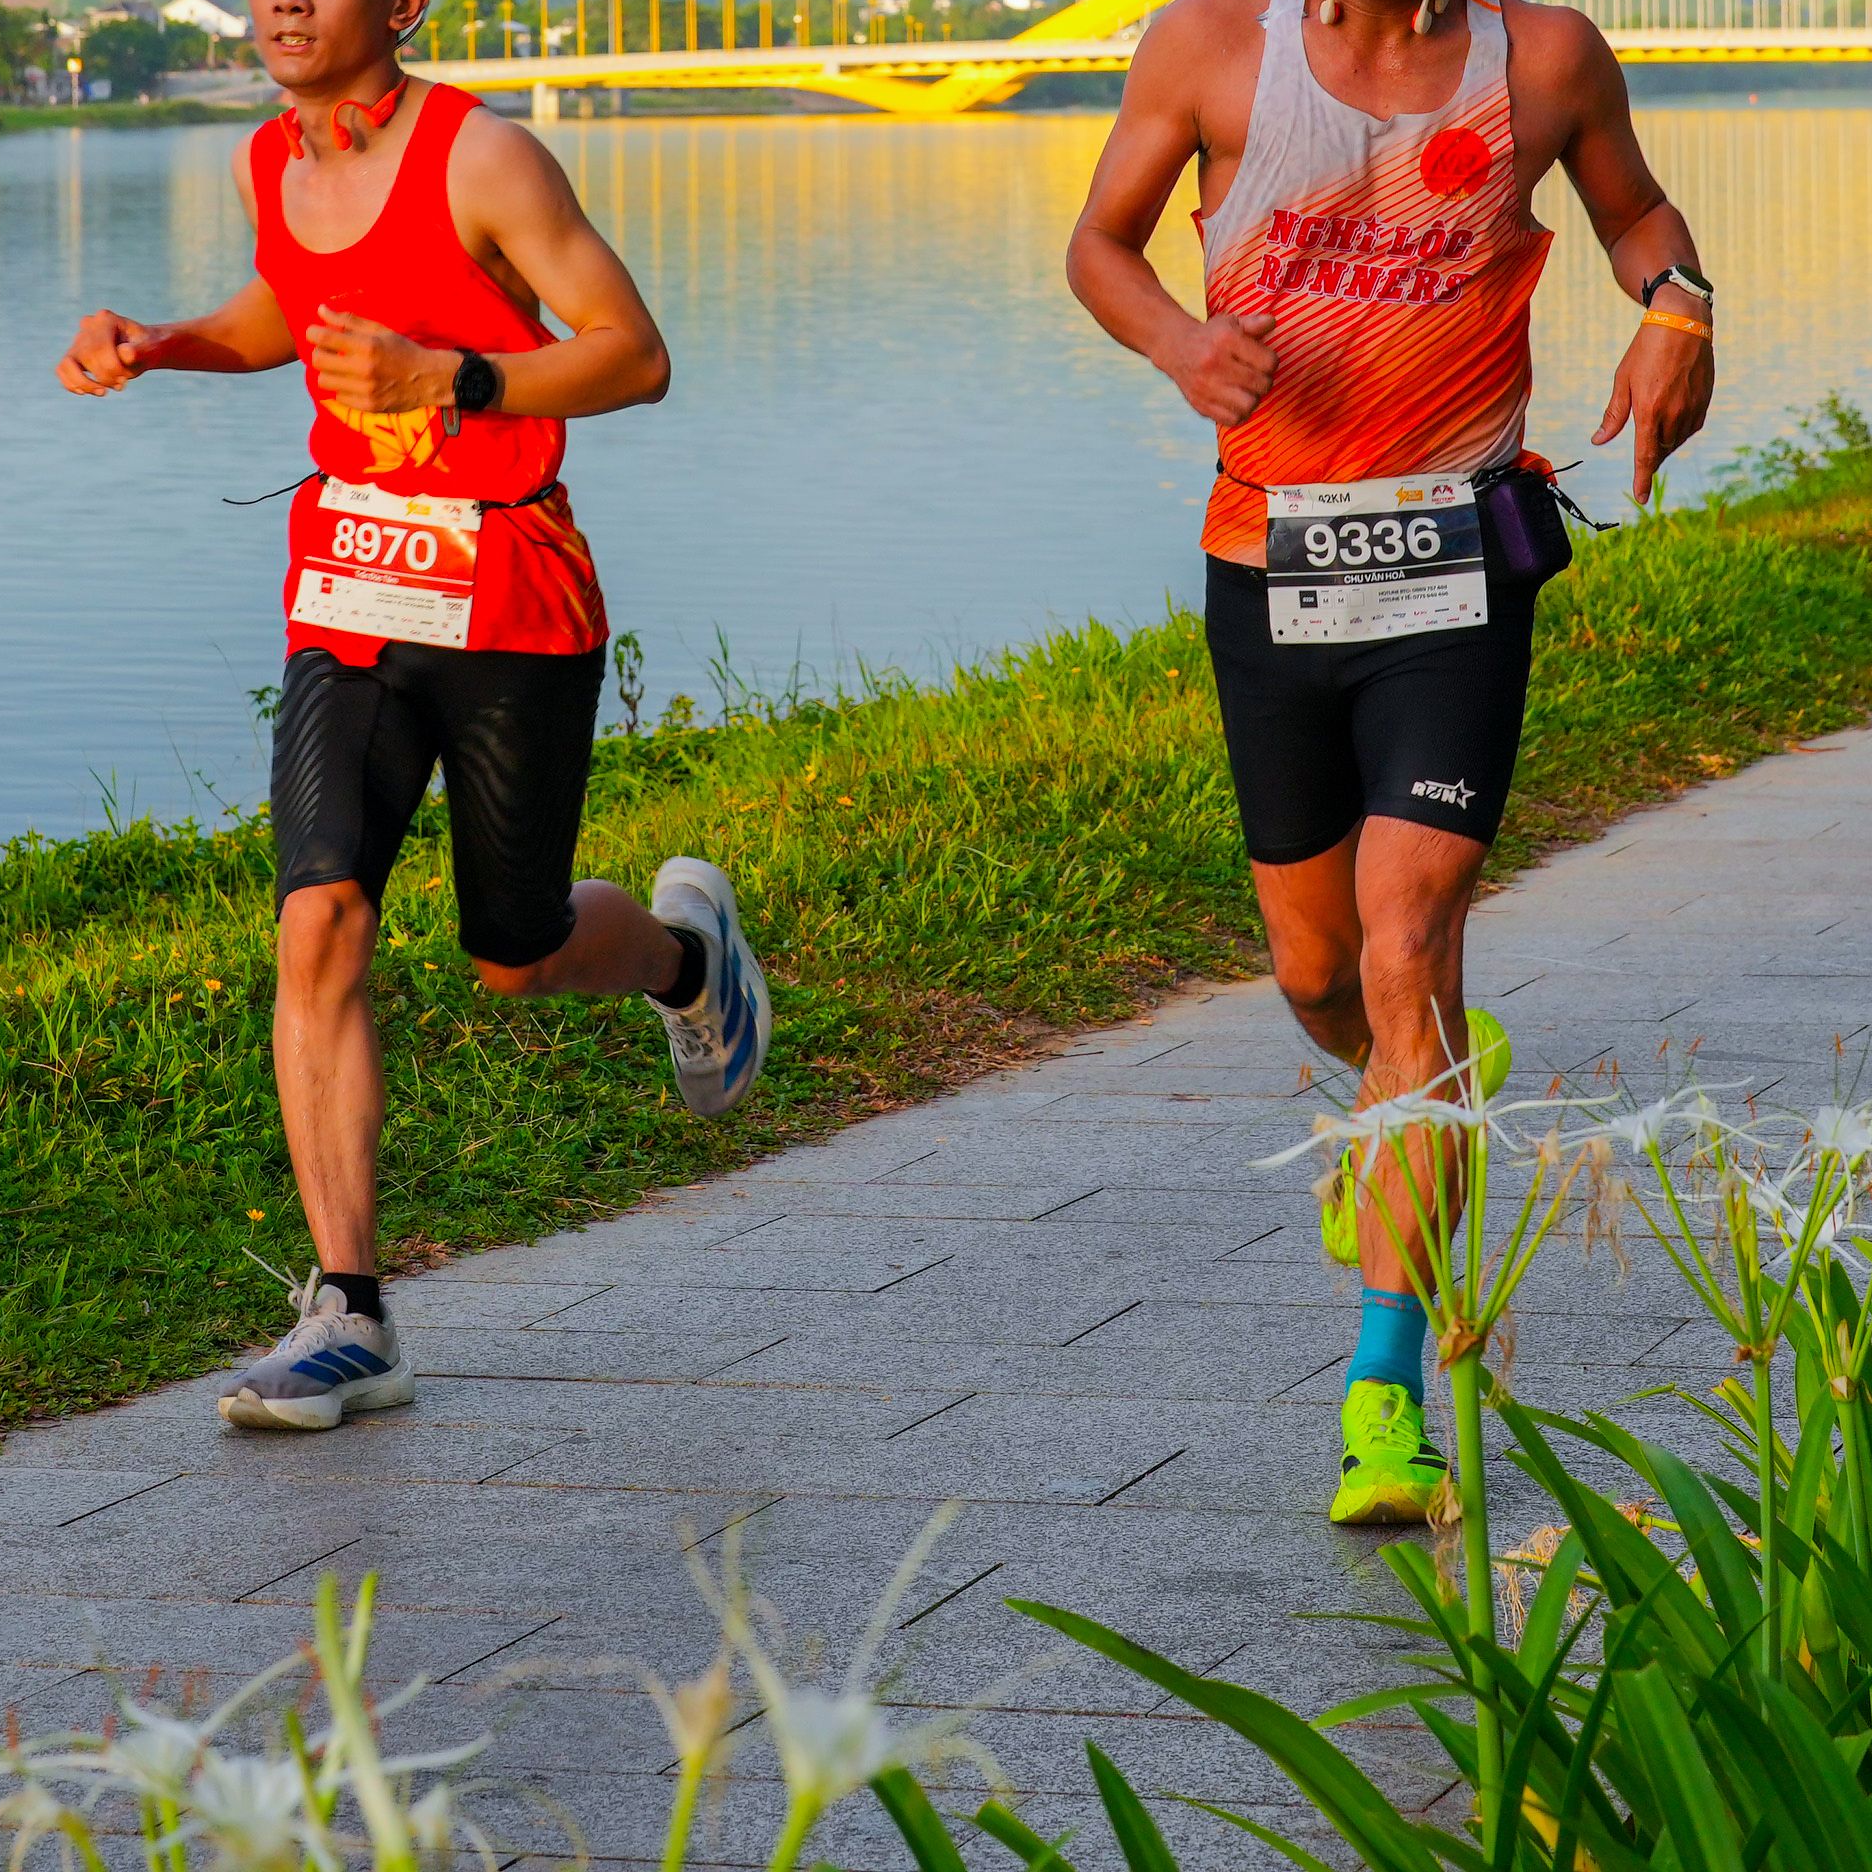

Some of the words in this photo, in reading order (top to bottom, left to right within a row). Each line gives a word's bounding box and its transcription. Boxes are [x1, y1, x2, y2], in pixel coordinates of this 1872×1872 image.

[1256, 254, 1472, 304] RUNNERS
[1318, 492, 1351, 504] 42KM
[332, 518, 438, 571] 8970
[1304, 517, 1442, 568] 9336
[1344, 574, 1364, 584] CHU
[1410, 781, 1457, 804] RUN
